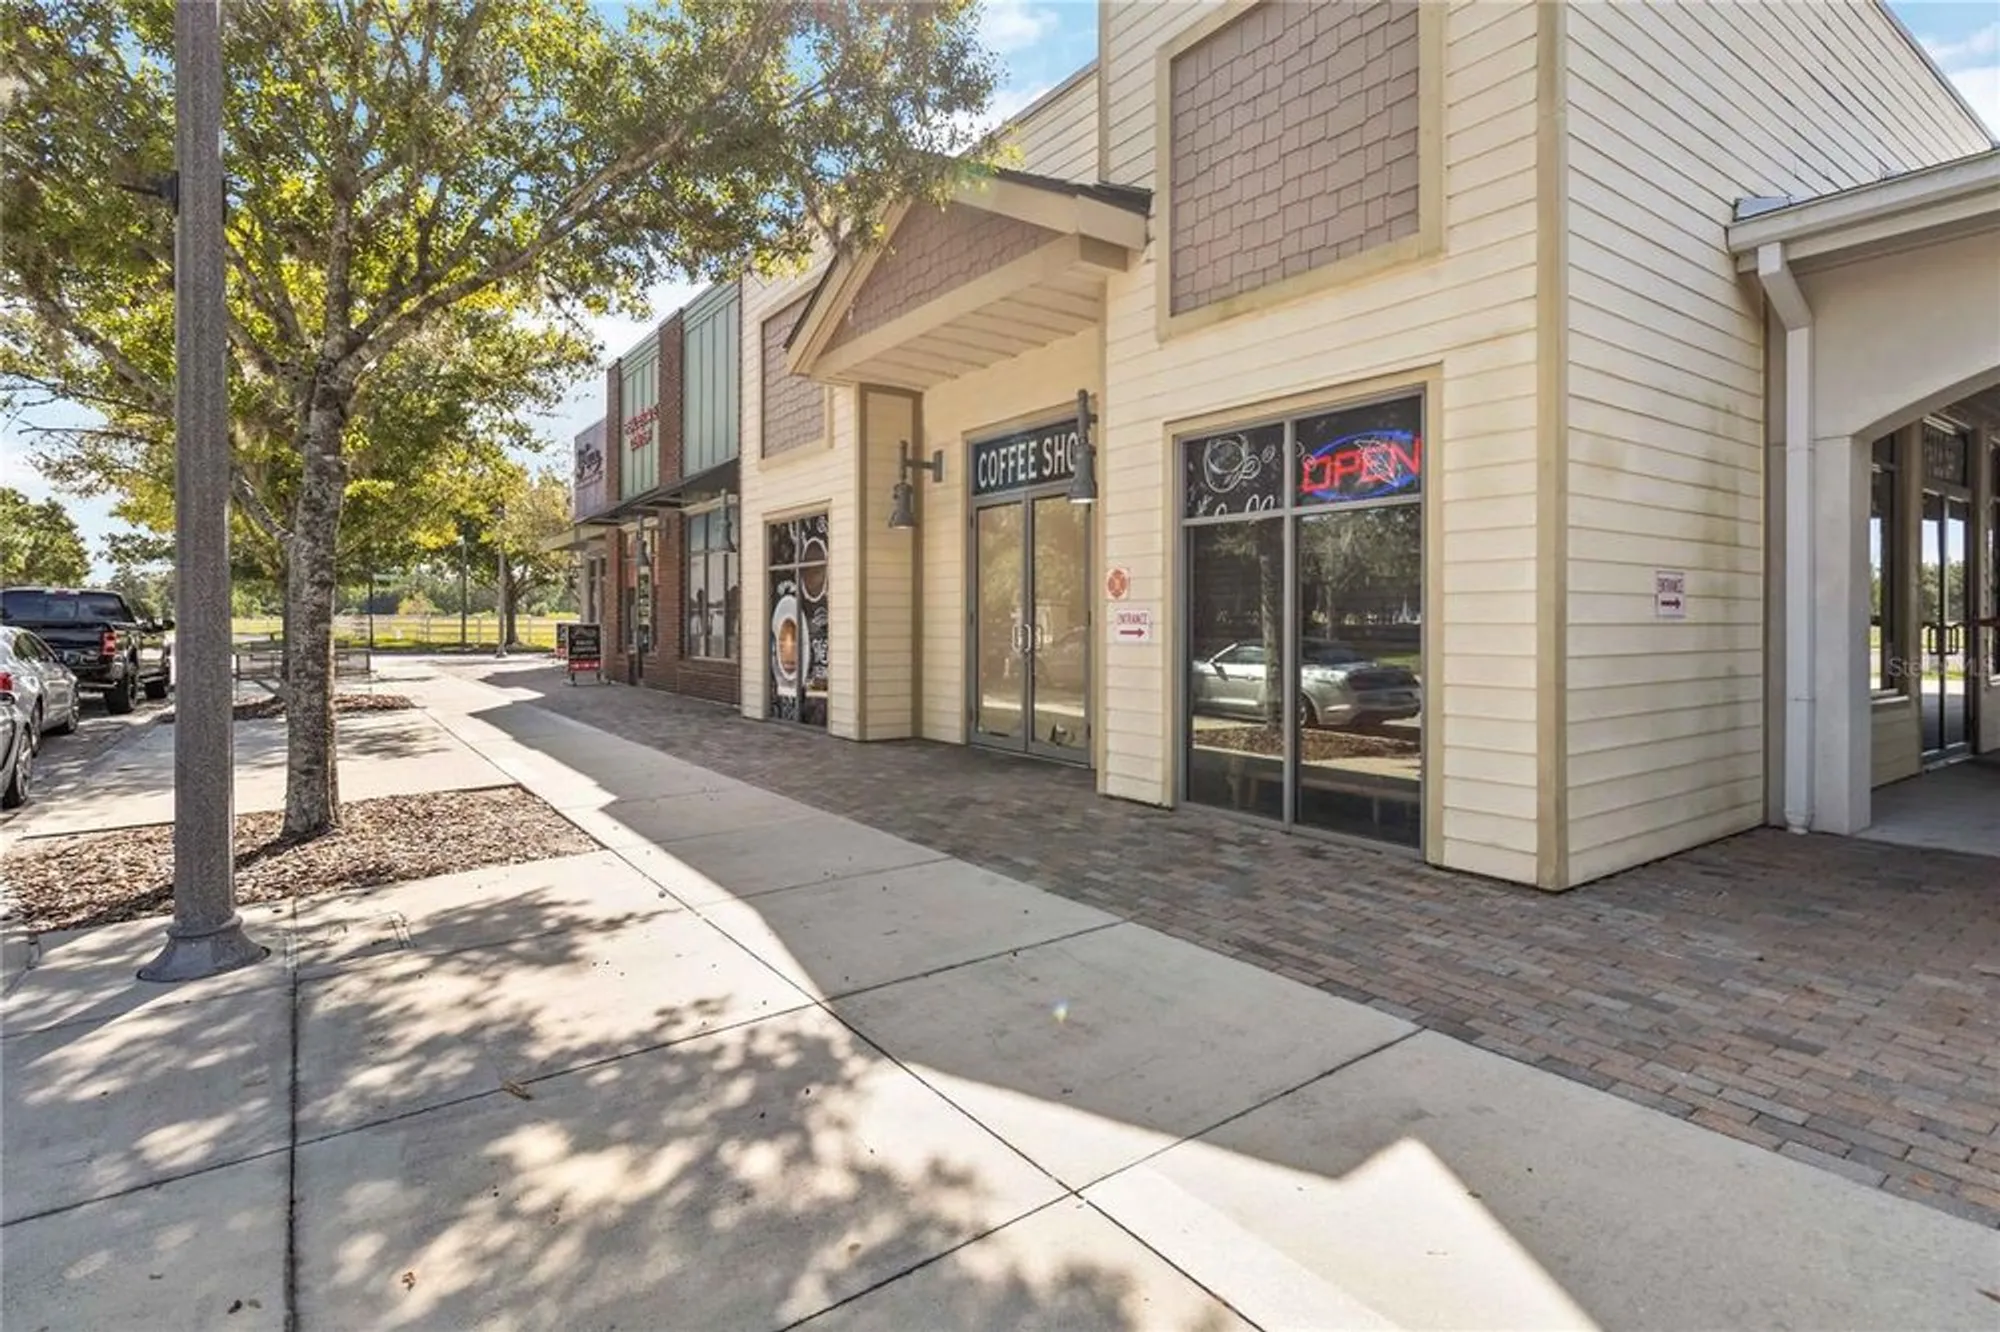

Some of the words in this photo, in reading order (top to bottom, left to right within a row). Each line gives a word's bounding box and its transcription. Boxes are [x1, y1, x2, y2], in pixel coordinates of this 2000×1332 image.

[978, 440, 1037, 488] COFFEE
[1042, 432, 1079, 477] SHO
[1301, 430, 1421, 494] OPEN
